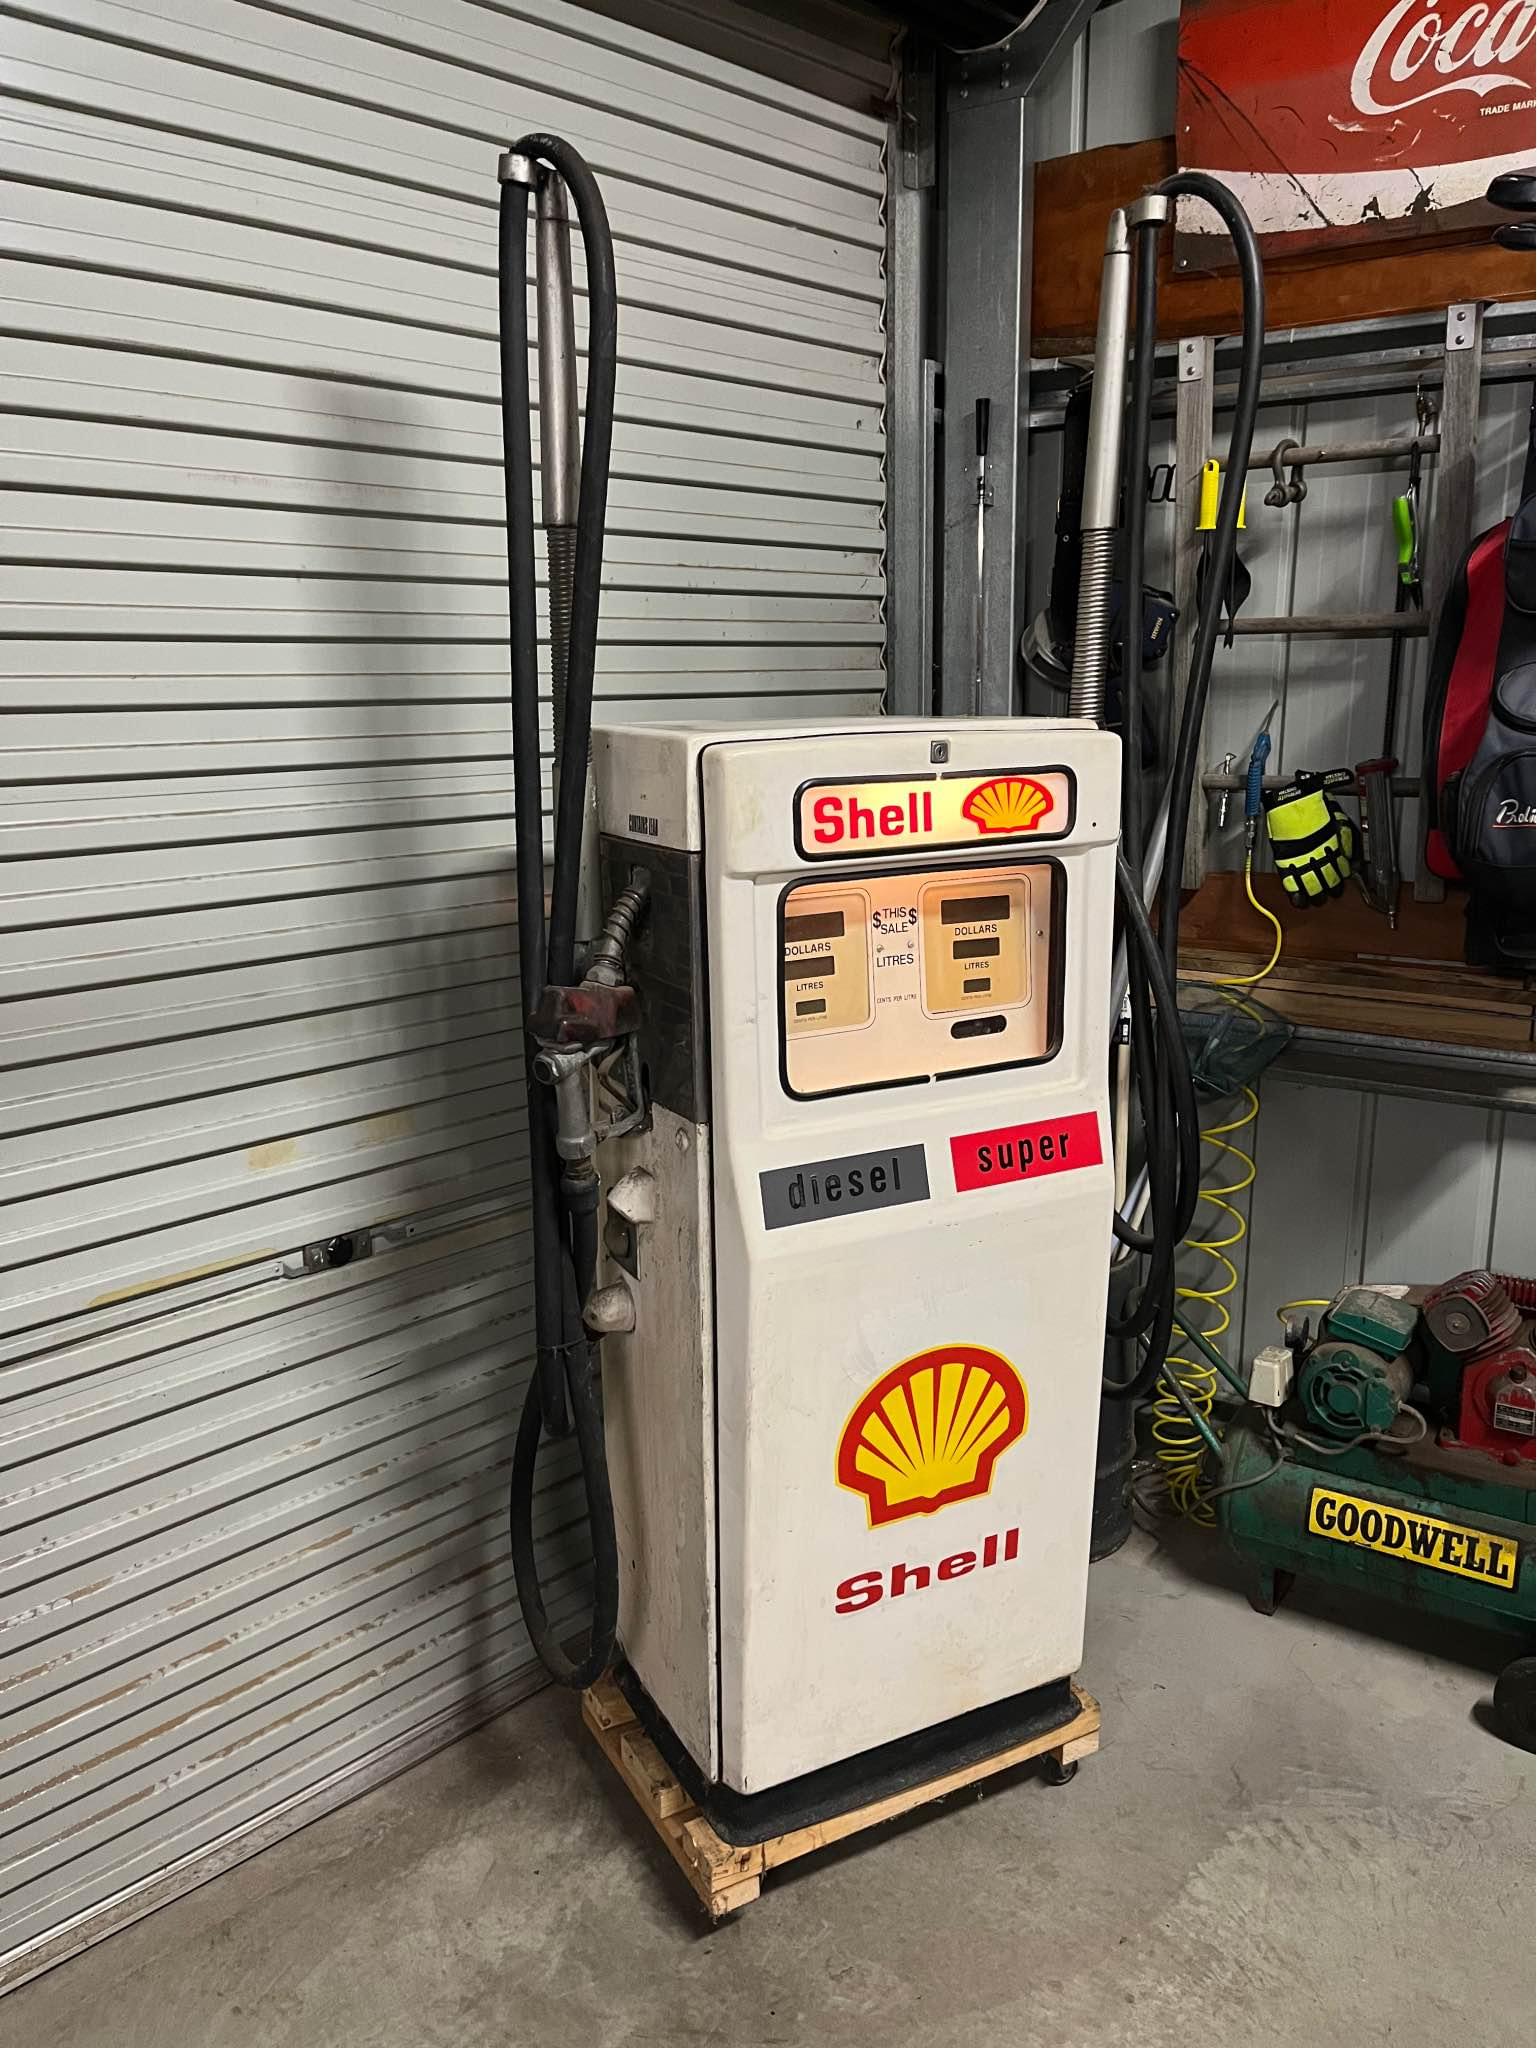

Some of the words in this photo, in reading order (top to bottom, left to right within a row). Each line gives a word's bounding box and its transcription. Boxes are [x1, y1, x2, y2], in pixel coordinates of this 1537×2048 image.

[1351, 0, 1536, 115] Coca
[1480, 104, 1510, 117] TRADE
[813, 792, 932, 843] Shell
[873, 911, 881, 929] $
[882, 907, 906, 919] THIS
[908, 907, 917, 925] $
[881, 922, 908, 934] SALE
[954, 924, 997, 936] DOLLARS
[785, 942, 831, 956] DOLLARS
[877, 953, 914, 967] LITRES
[964, 961, 989, 970] LITRES
[796, 981, 824, 991] LITRES
[978, 1132, 1070, 1172] super
[788, 1157, 901, 1210] diesel
[1315, 1497, 1509, 1581] GOODWELL
[835, 1527, 1019, 1614] Shell
